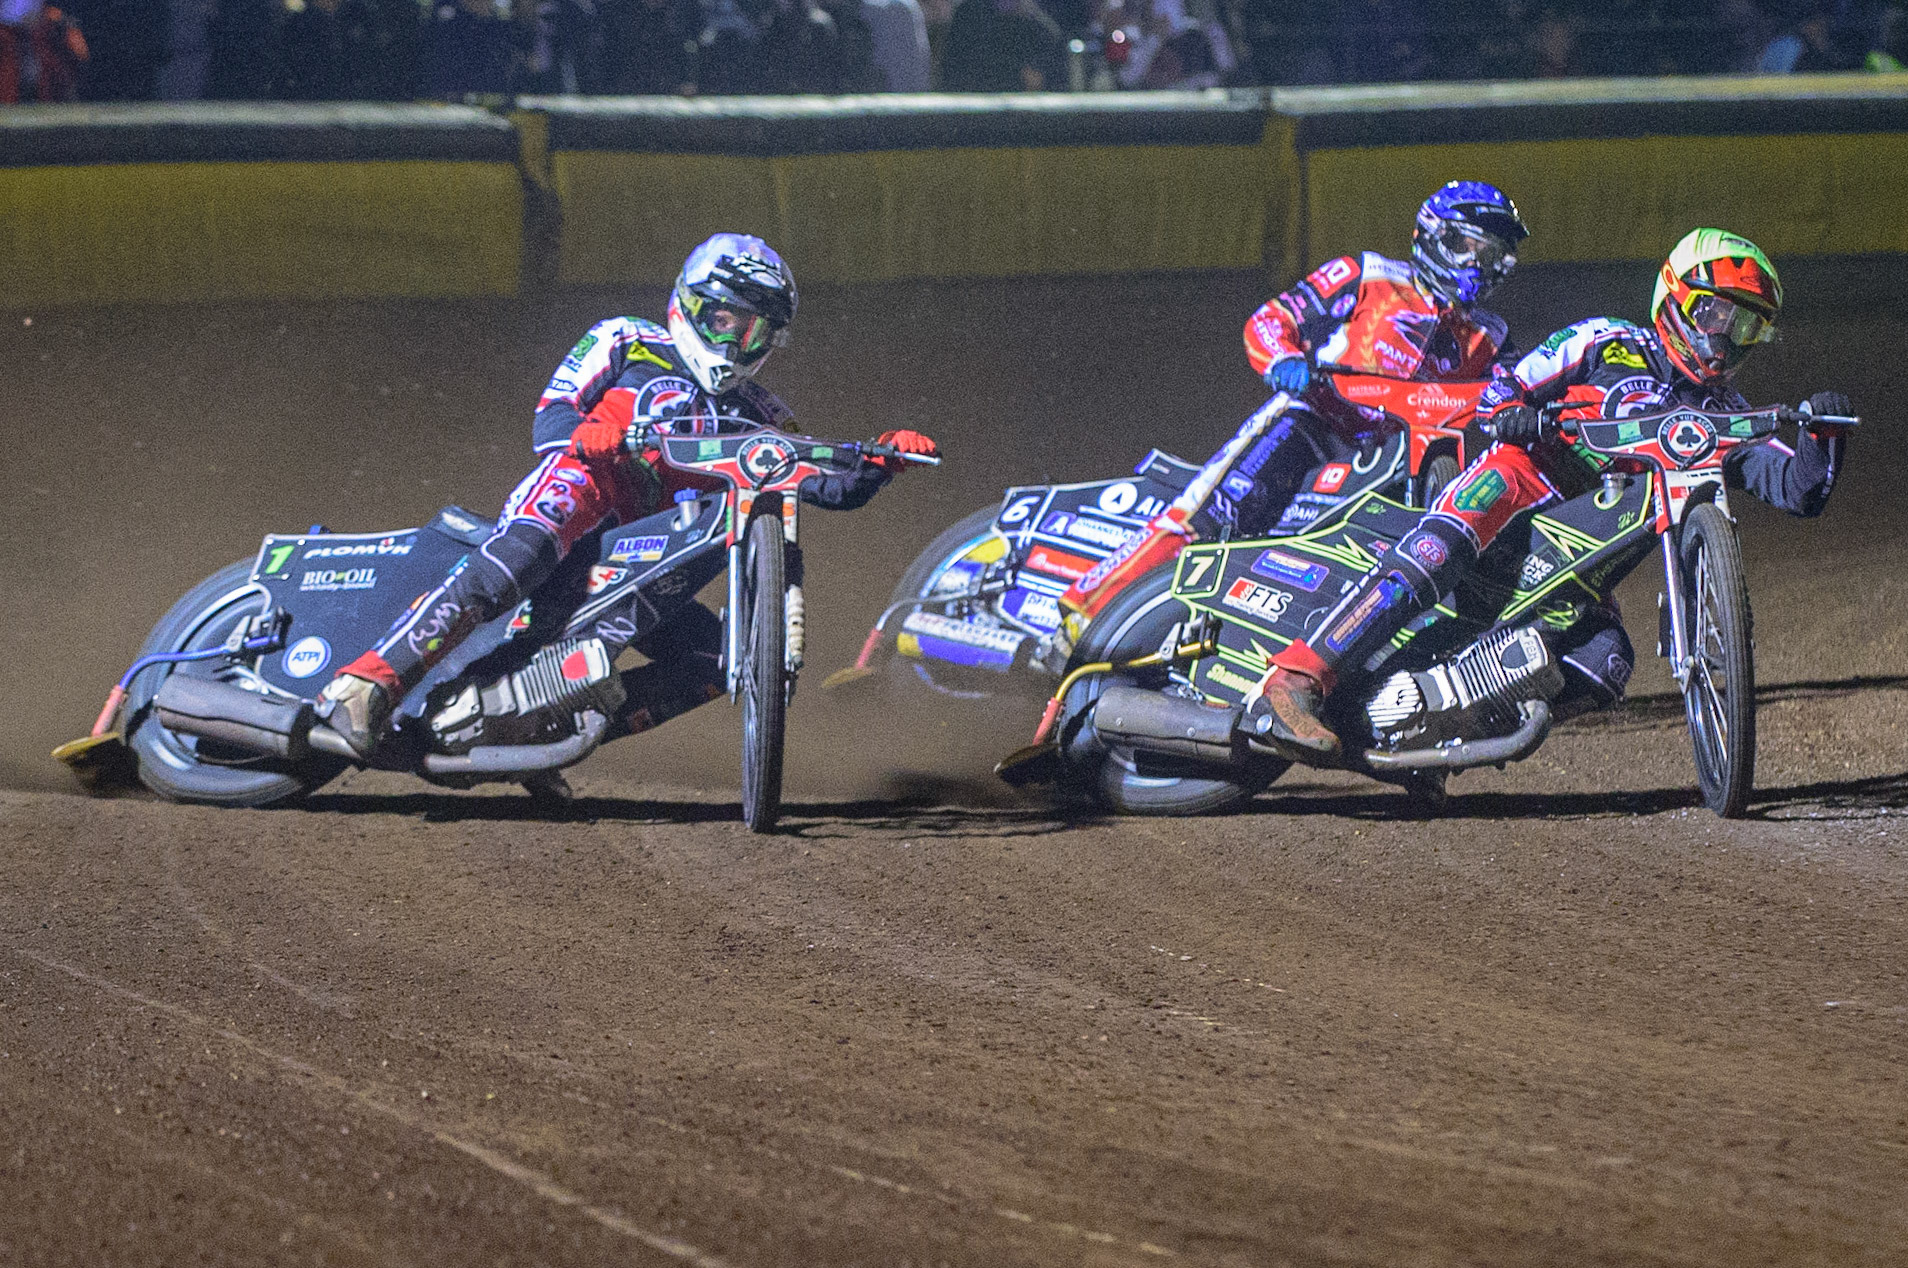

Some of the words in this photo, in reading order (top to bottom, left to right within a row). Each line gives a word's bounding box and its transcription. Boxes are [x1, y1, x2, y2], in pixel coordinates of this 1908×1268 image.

[650, 380, 682, 395] BELLE
[1619, 380, 1653, 395] BELLE
[1407, 393, 1467, 408] Crendon
[1661, 417, 1678, 435] BELLE
[1001, 496, 1040, 523] 6
[614, 536, 666, 553] ALBON
[264, 544, 295, 575] 1
[1184, 555, 1215, 587] 7
[1246, 585, 1292, 614] FTS
[292, 651, 321, 663] ATPI
